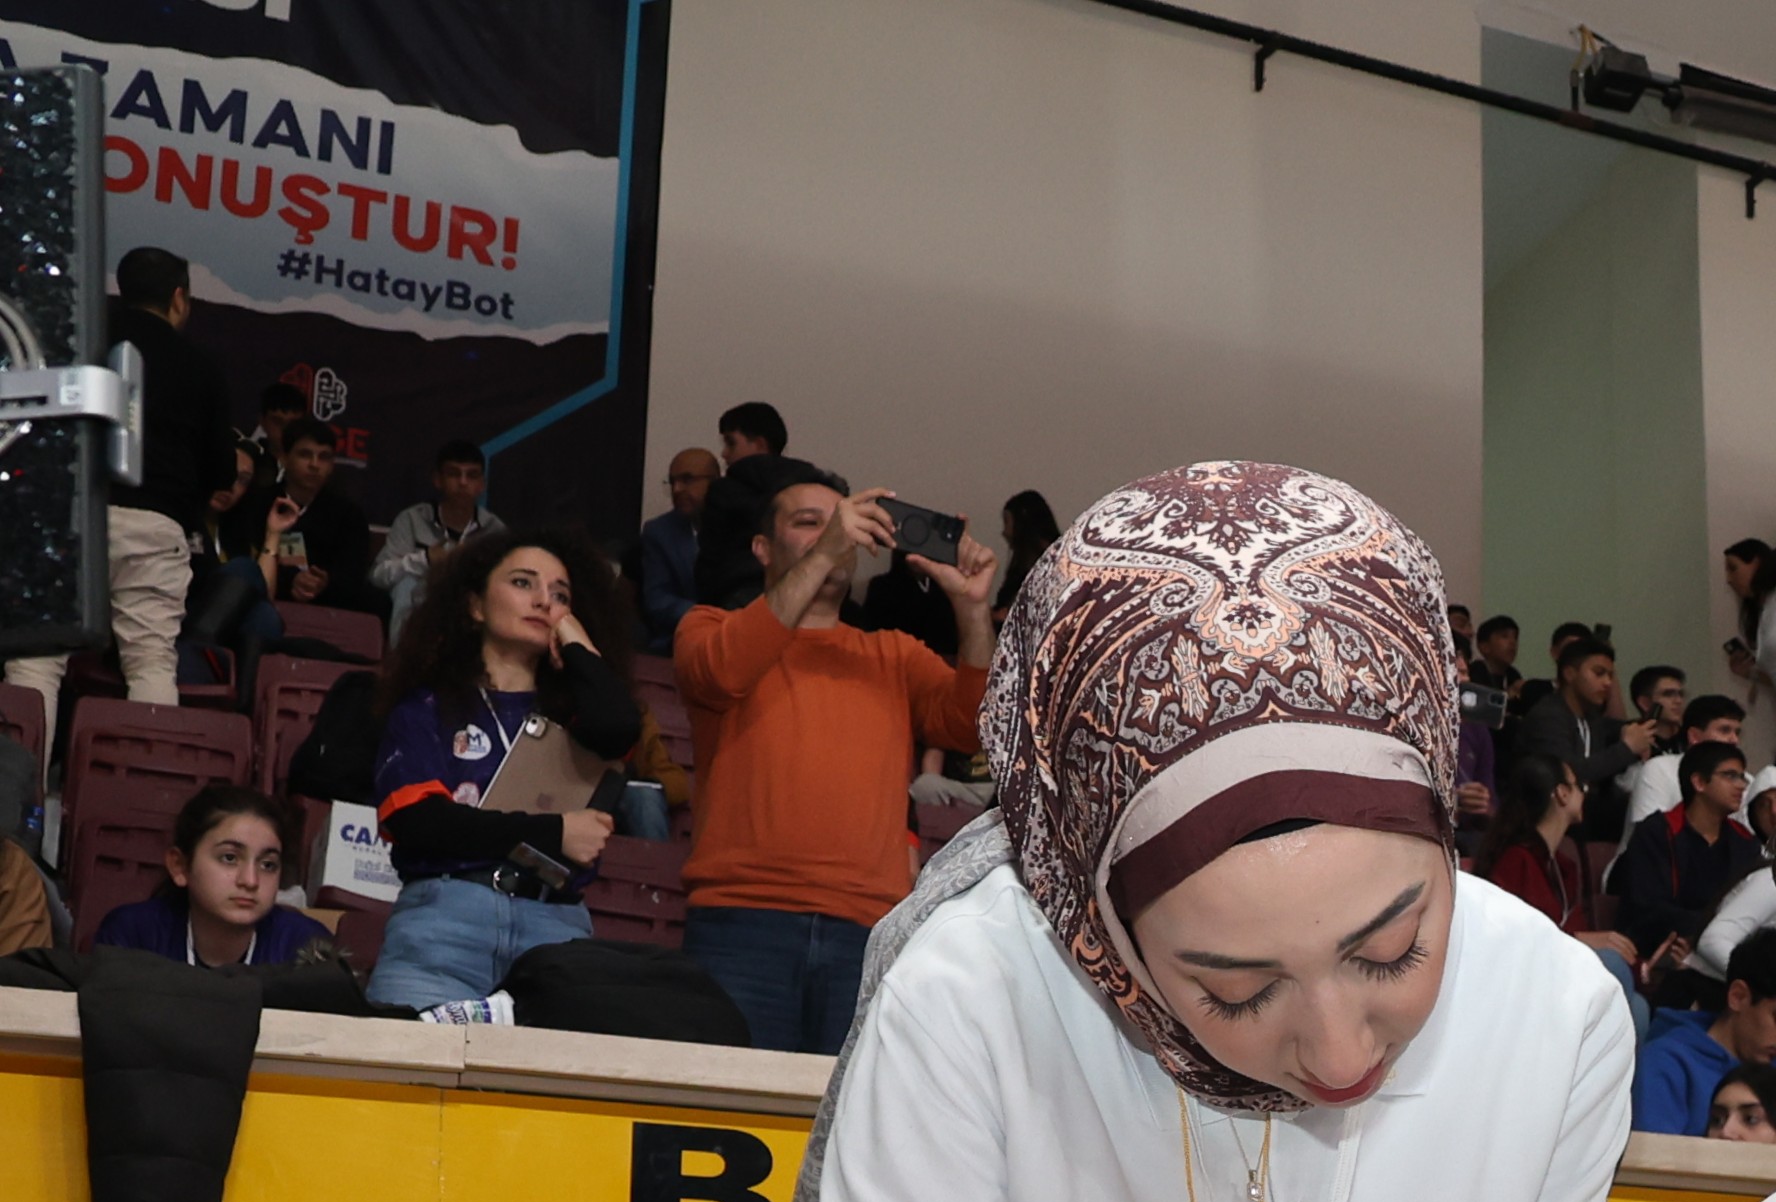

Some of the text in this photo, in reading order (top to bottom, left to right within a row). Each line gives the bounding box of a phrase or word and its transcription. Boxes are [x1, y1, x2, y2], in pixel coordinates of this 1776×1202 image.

[62, 51, 395, 175] AMANI
[103, 135, 520, 271] ONUŞTUR!
[277, 249, 515, 320] #HatayBot
